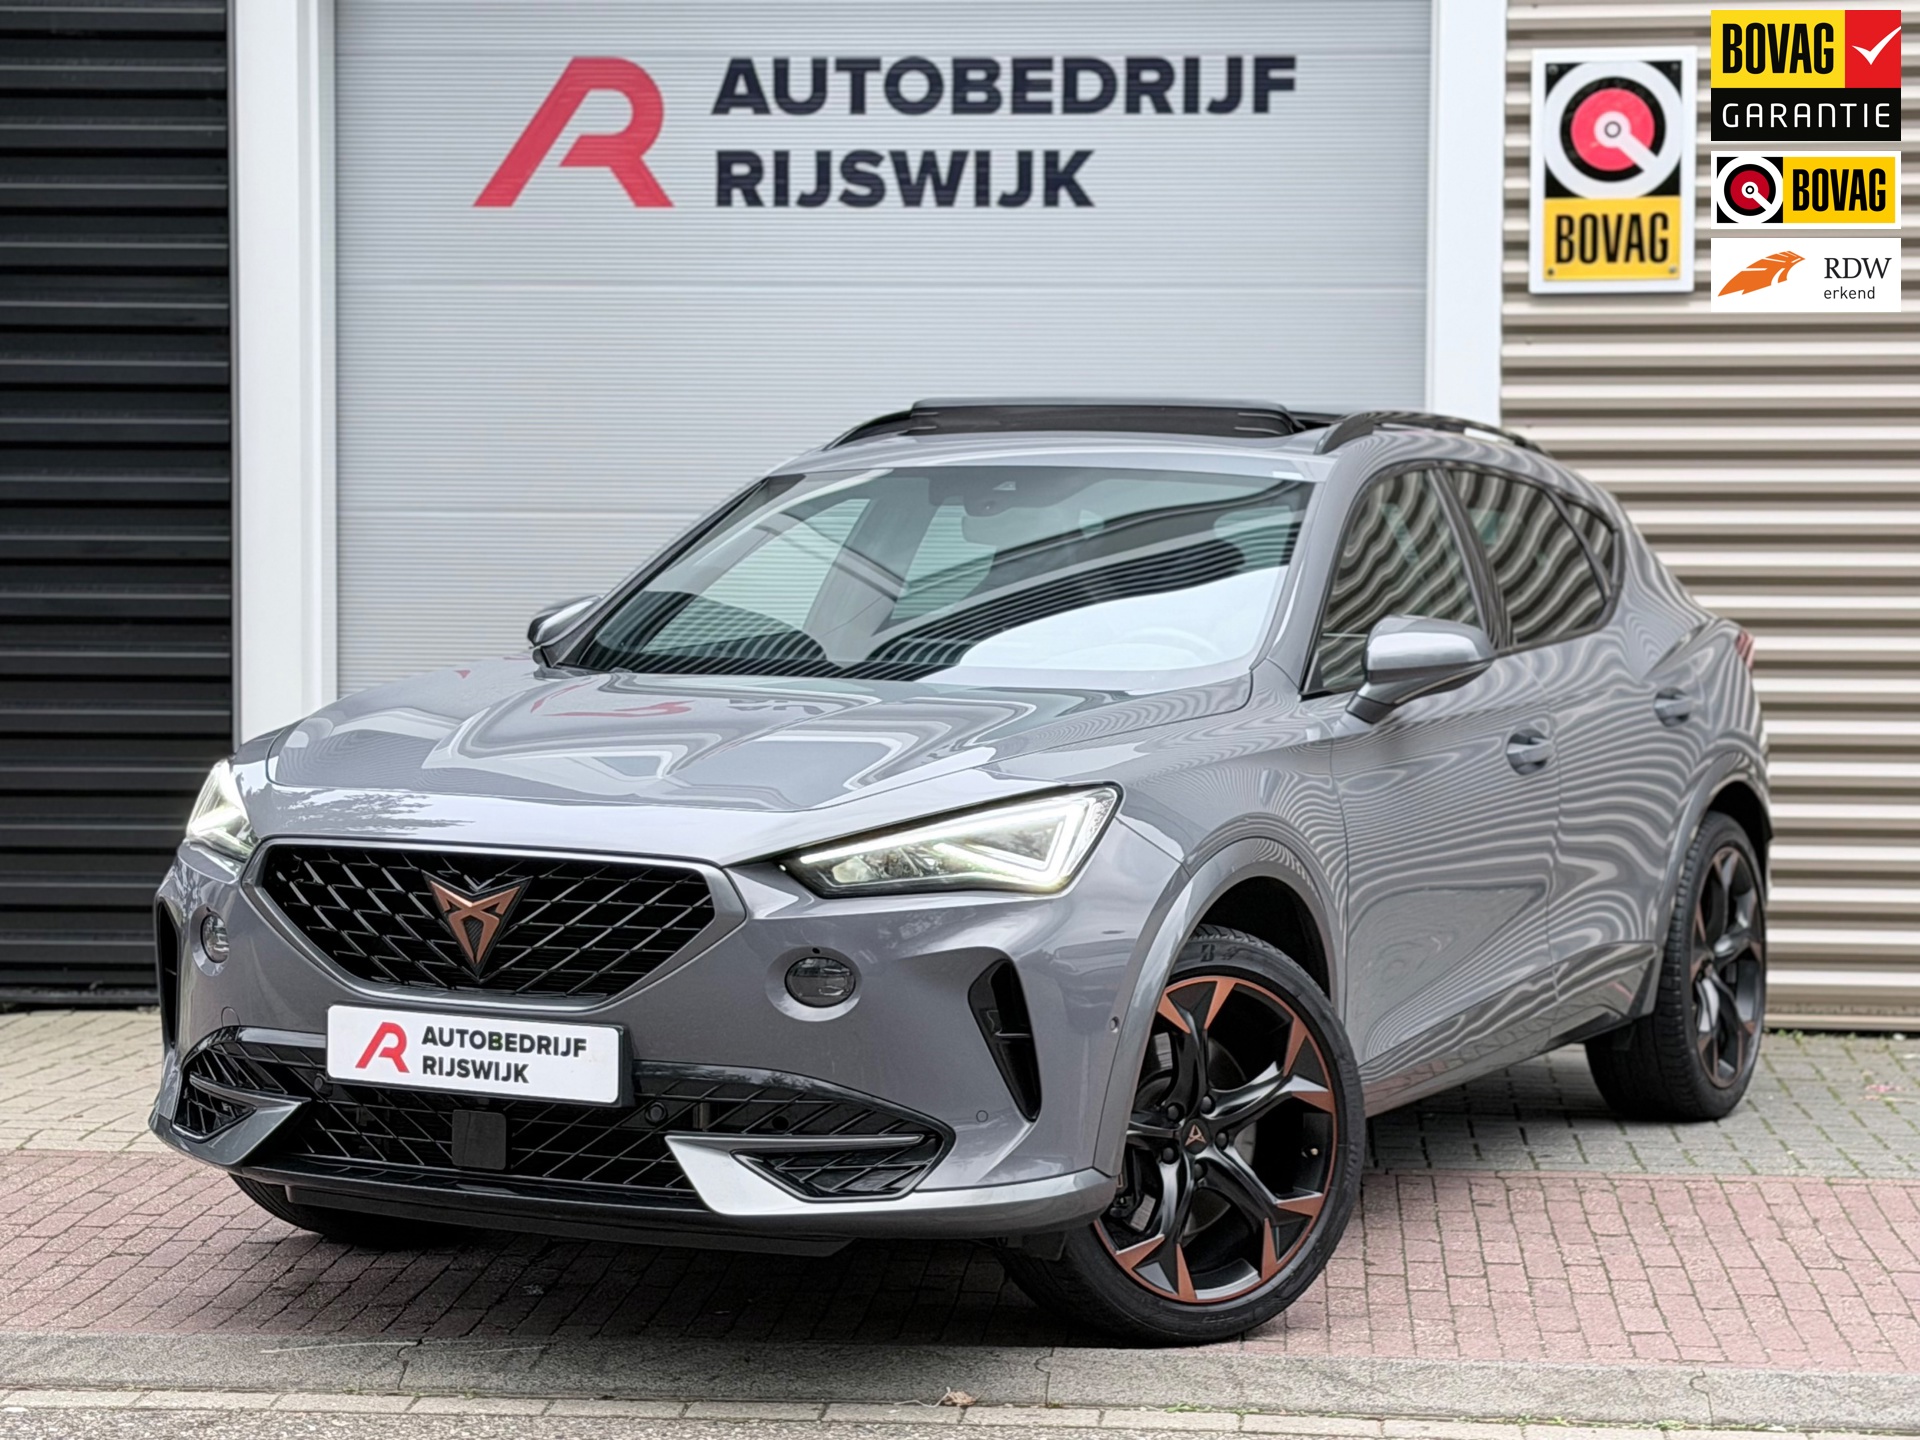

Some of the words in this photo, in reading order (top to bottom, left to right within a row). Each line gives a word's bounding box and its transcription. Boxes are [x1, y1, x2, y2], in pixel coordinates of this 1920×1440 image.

[712, 56, 1296, 116] AUTOBEDRIJF
[716, 150, 1095, 208] RIJSWIJK
[1555, 213, 1669, 264] BOVAG
[421, 1026, 587, 1057] AUTOBEDRIJF
[422, 1056, 530, 1083] RIJSWIJK
